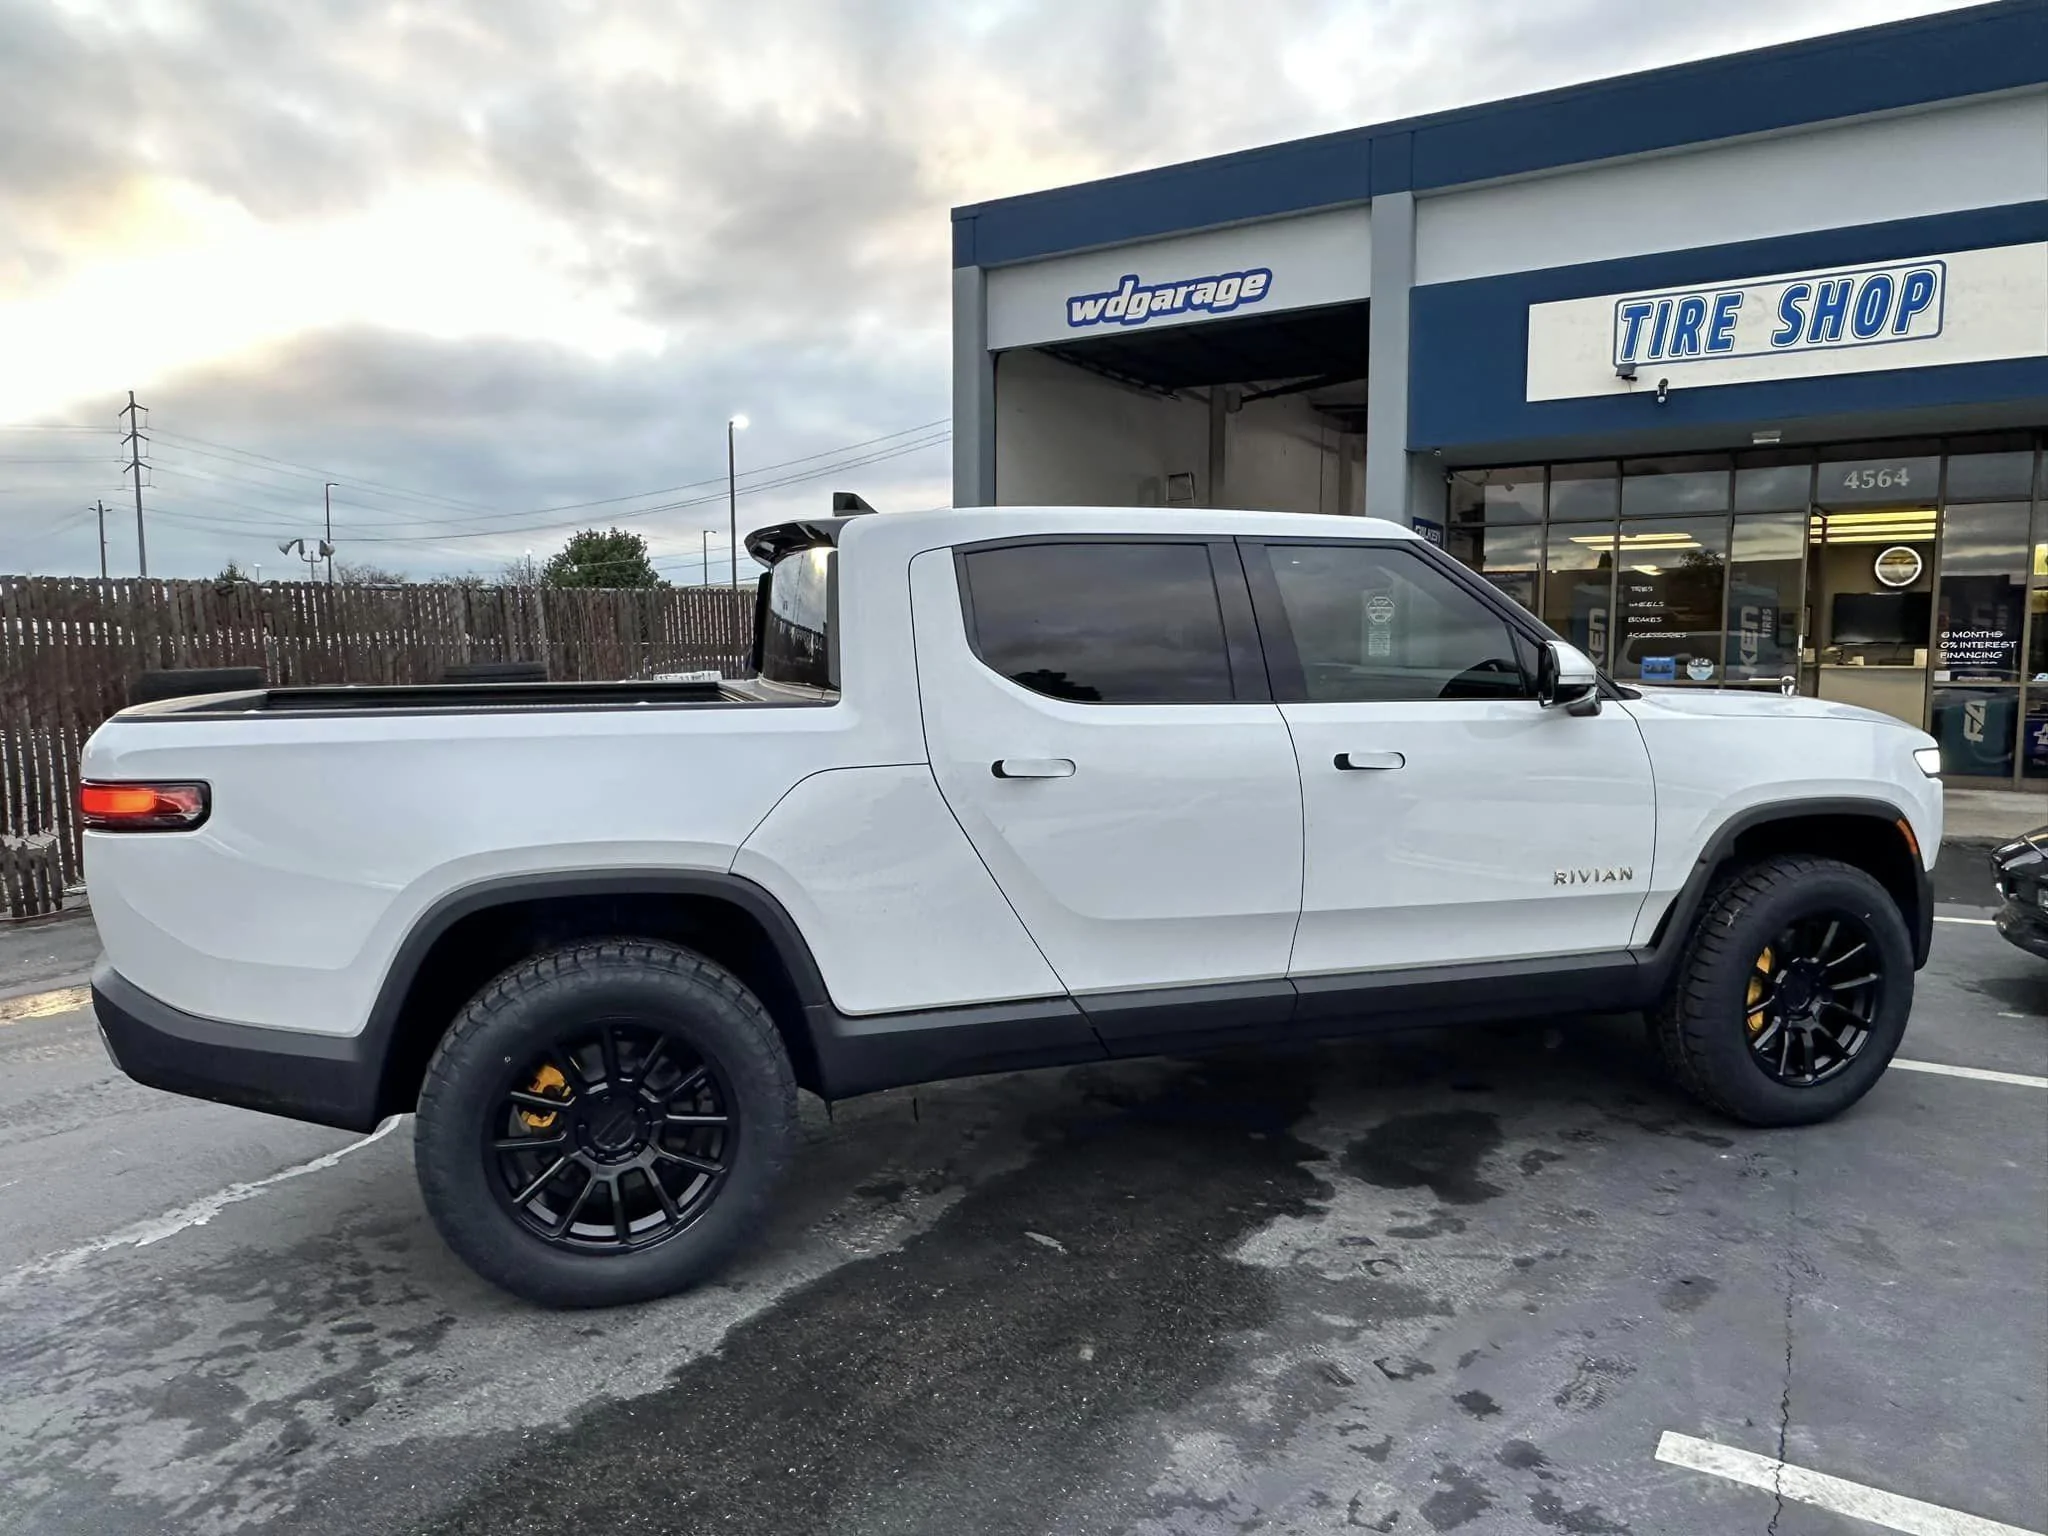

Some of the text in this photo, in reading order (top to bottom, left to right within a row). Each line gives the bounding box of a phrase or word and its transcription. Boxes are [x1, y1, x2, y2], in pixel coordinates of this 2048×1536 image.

[1069, 272, 1270, 325] wdgarage
[1621, 269, 1937, 361] TIRE SHOP
[1843, 467, 1910, 489] 4564
[1952, 631, 2003, 639] MONTHS
[1940, 641, 2016, 649] 0% INTEREST
[1940, 651, 2003, 659] FINANCING
[1553, 866, 1633, 885] RIVIAN
